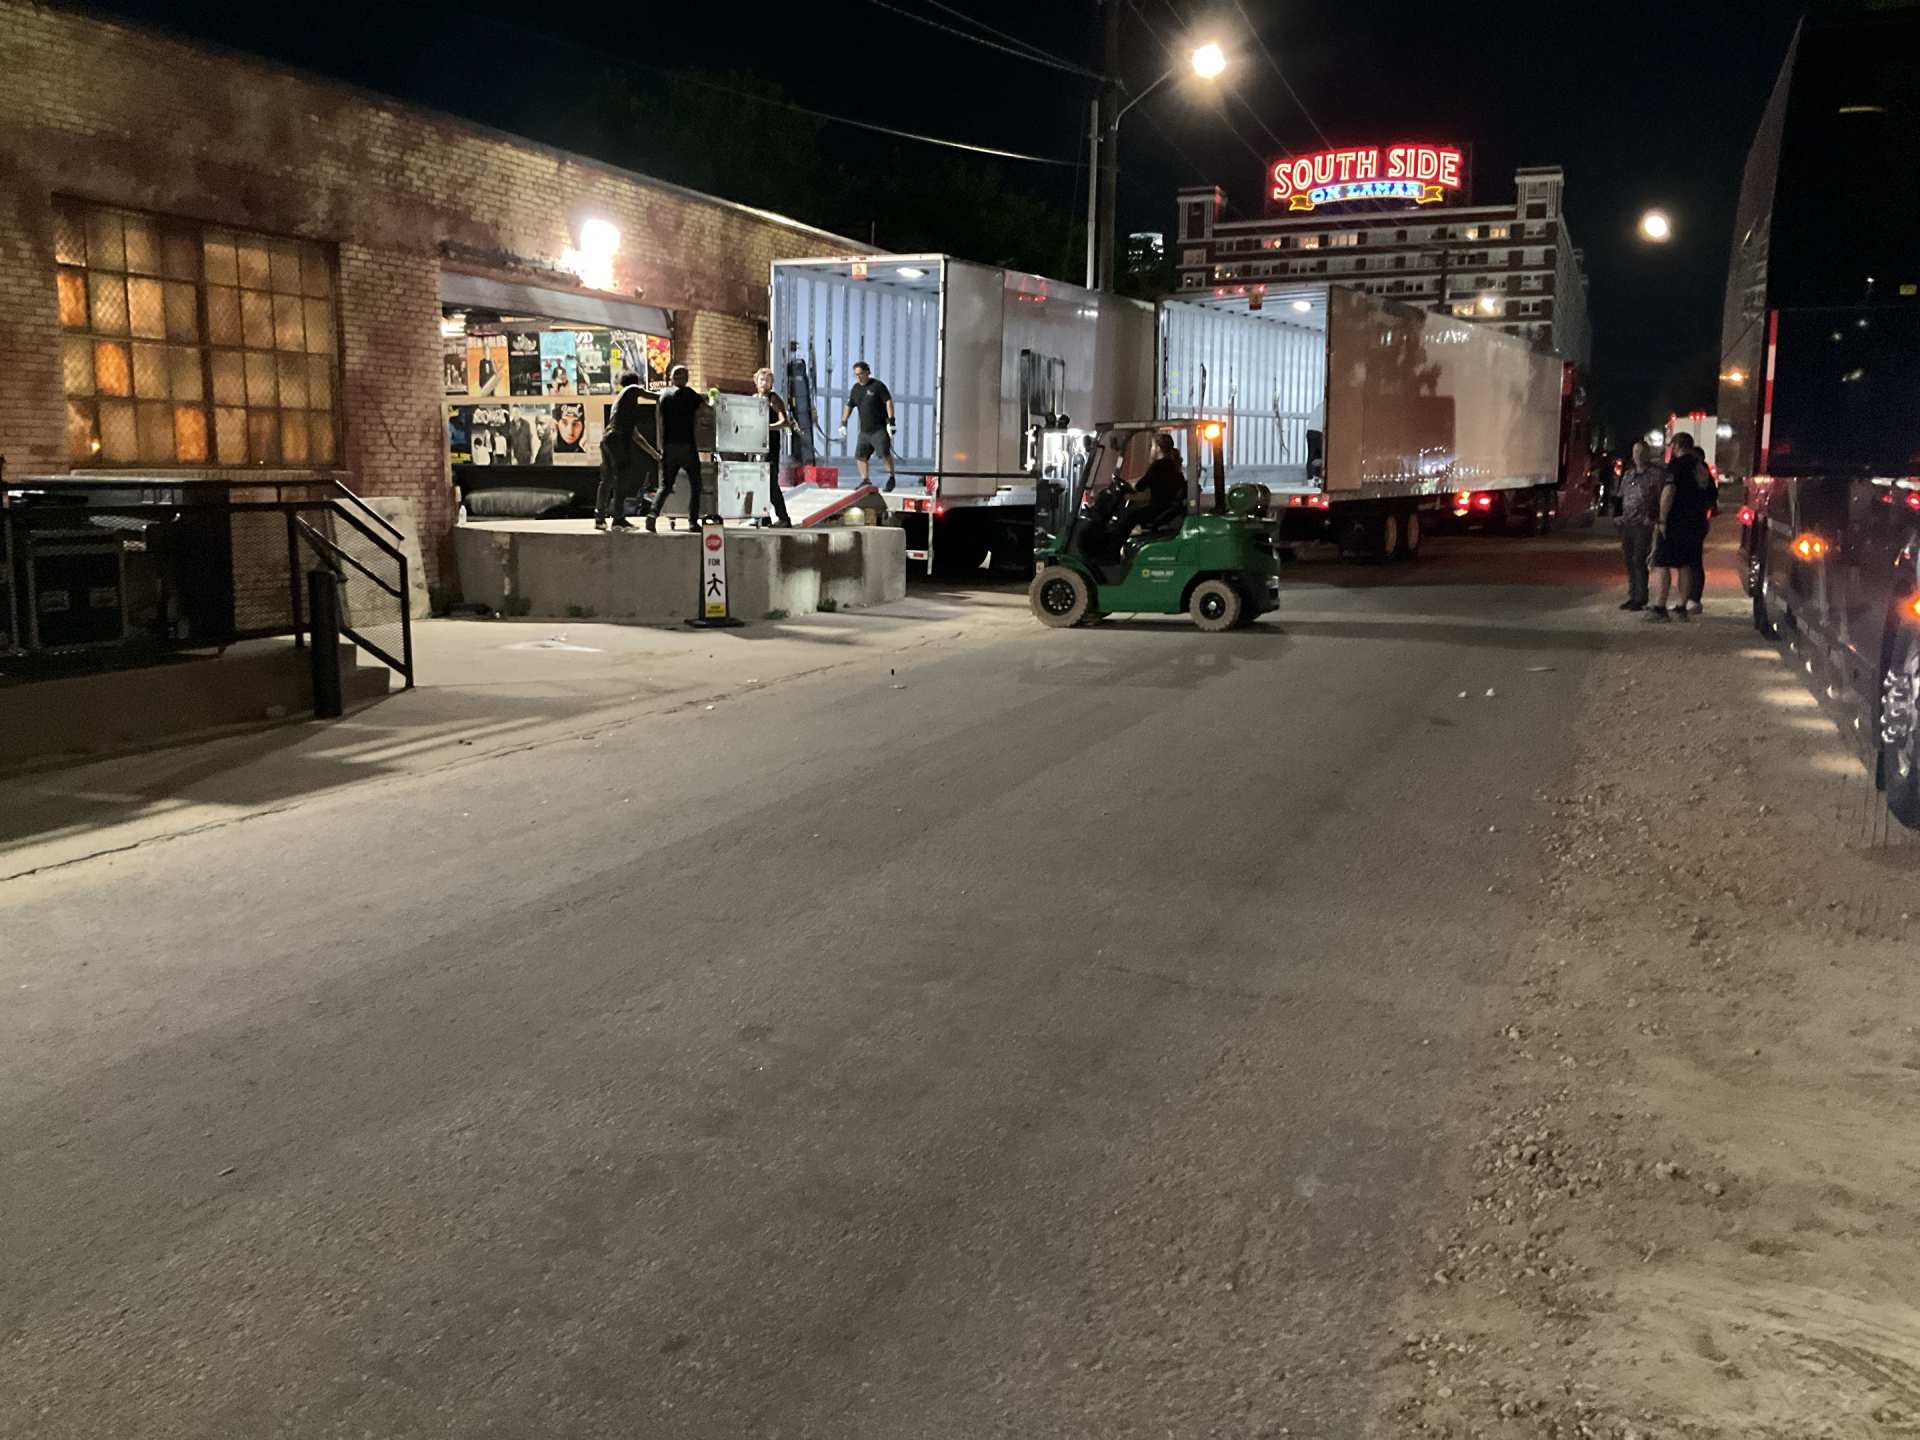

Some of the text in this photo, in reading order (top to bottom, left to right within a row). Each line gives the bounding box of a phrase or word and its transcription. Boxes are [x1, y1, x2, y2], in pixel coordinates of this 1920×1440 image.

[1273, 148, 1460, 200] SOUTH SIDE
[1310, 183, 1420, 204] ON LAMAR
[706, 539, 721, 547] STOP
[708, 558, 721, 566] FOR
